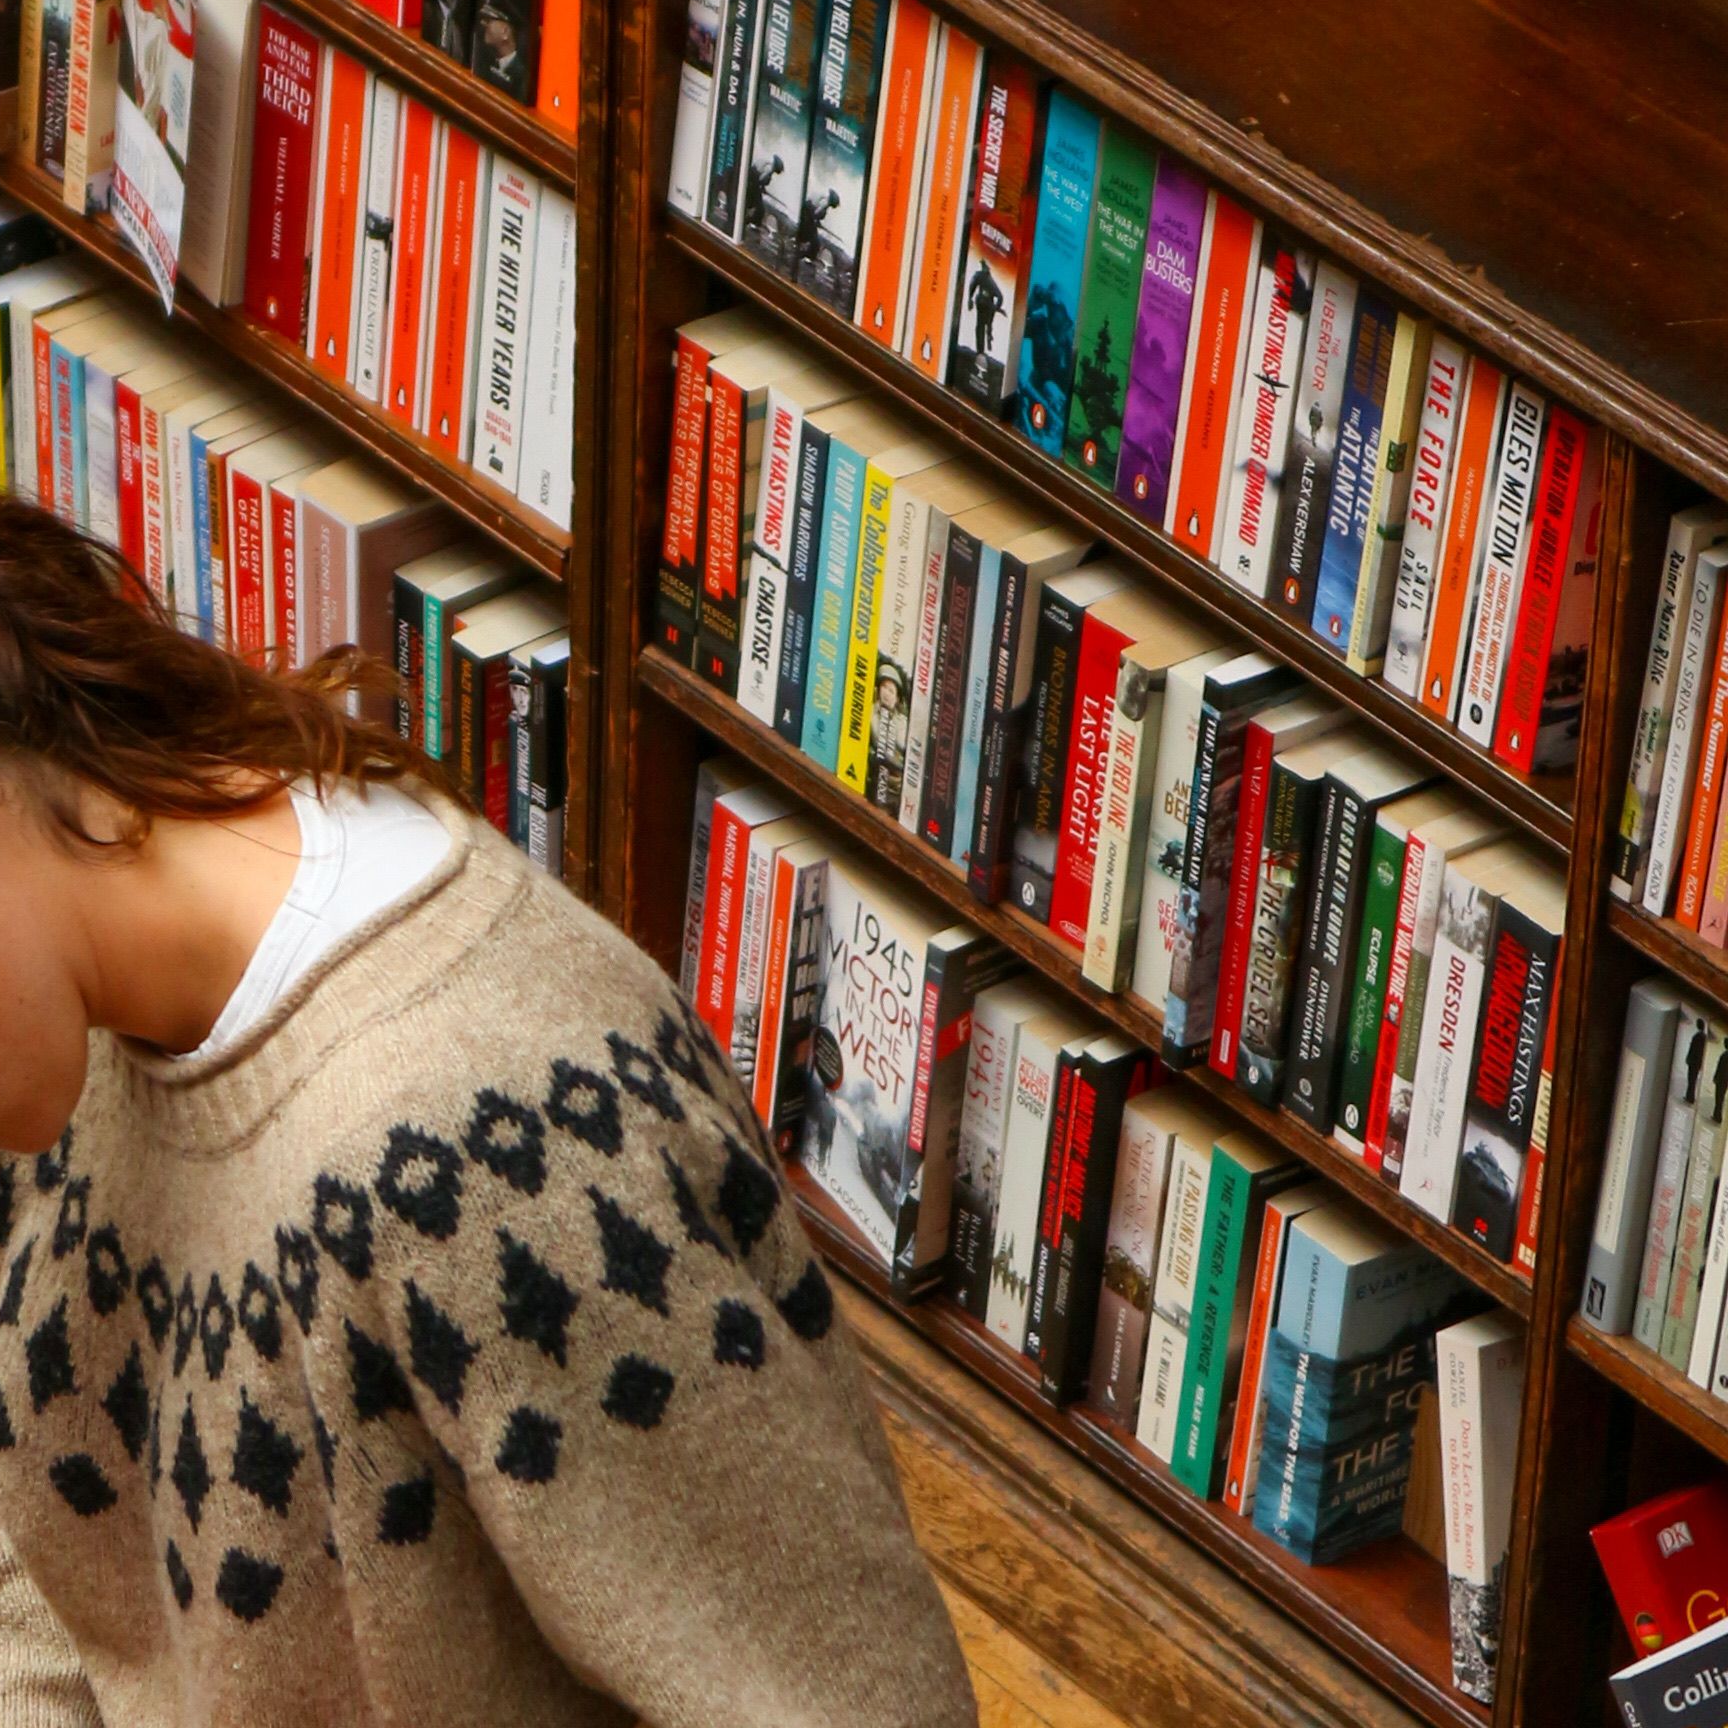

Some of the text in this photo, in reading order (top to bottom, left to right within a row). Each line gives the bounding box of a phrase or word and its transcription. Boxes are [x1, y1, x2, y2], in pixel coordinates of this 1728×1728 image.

[68, 79, 87, 135] BERLIN
[75, 58, 89, 77] IN
[262, 65, 311, 107] THIRD
[262, 84, 309, 125] REICH
[1145, 254, 1193, 294] BUSTERS
[1157, 240, 1186, 270] DAM
[490, 206, 523, 411] THE HITLER YEARS
[764, 406, 793, 551] MAX HASTINGS
[1411, 359, 1454, 531] THE FORCE
[1492, 396, 1539, 568] GILES MILTON
[1290, 455, 1315, 573] ALEX KERSHAW
[752, 576, 776, 671] CHASTISE
[1069, 694, 1100, 844] LAST LIGHT
[852, 902, 914, 998] 1945
[1441, 955, 1466, 1053] DRESDEN
[1506, 953, 1546, 1125] MAX HASTINGS
[837, 1011, 905, 1105] WEST
[1657, 1522, 1693, 1557] DK
